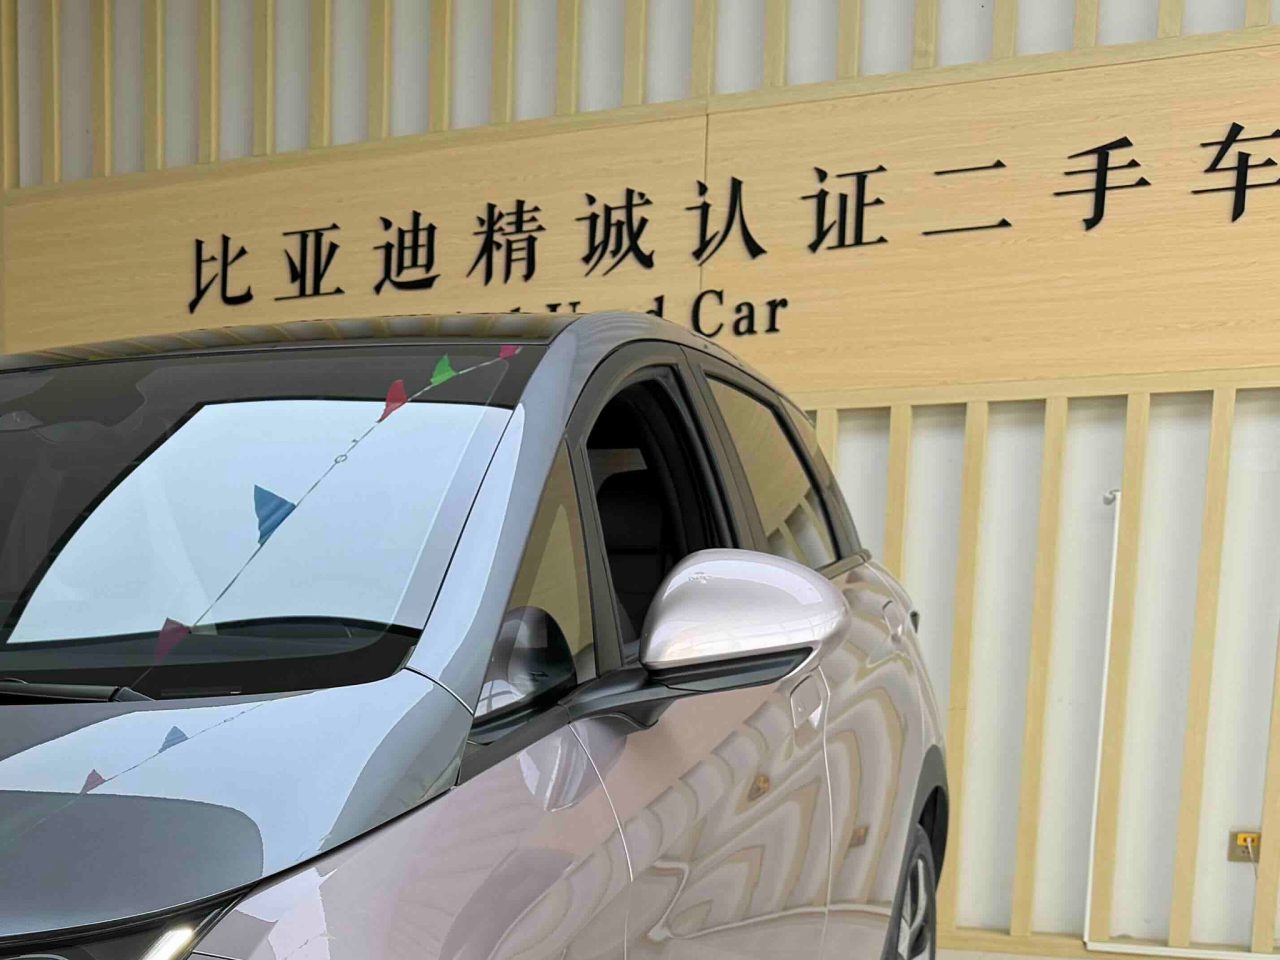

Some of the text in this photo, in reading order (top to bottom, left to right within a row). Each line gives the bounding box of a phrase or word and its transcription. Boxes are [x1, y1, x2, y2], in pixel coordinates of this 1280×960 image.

[187, 121, 1280, 315] 比亚迪精诚认证二手车
[691, 289, 789, 338] Car
